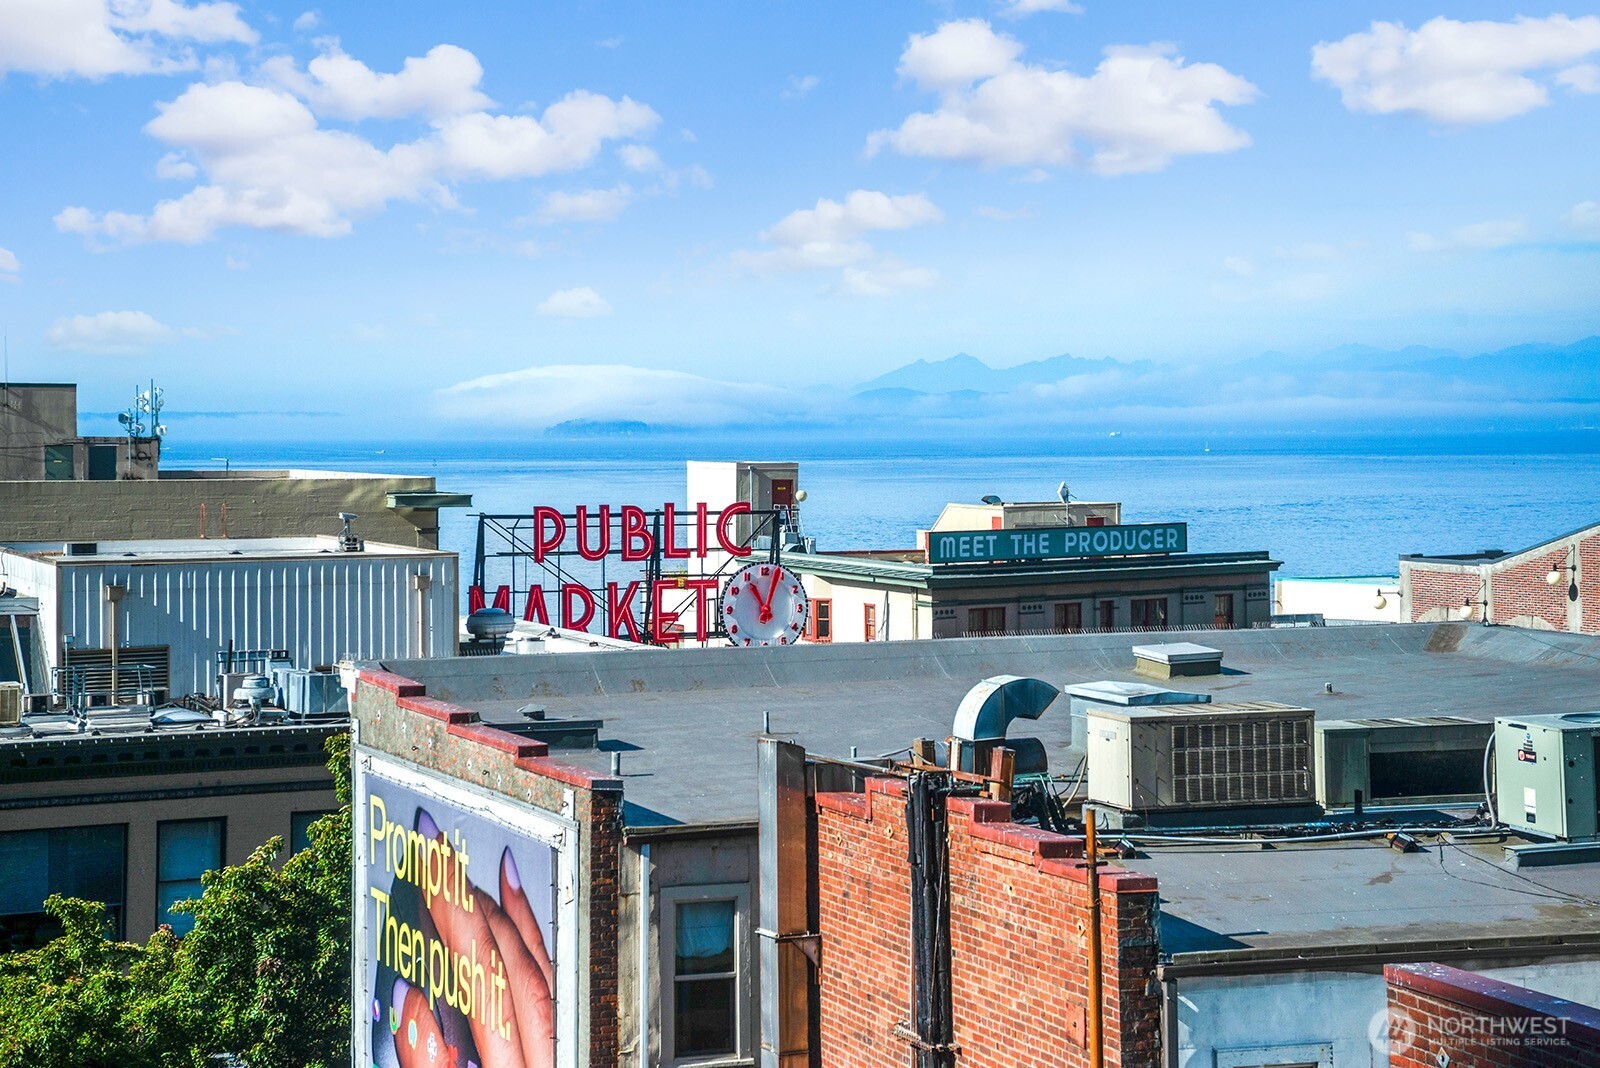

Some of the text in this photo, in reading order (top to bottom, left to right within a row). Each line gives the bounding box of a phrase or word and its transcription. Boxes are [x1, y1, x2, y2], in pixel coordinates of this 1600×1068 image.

[533, 502, 752, 563] PUBLIC
[940, 528, 1179, 559] MEET THE PRODUCER
[760, 566, 770, 576] 12
[743, 572, 751, 581] 11
[729, 586, 740, 596] 10
[792, 585, 799, 594] 2
[726, 605, 734, 615] 9
[796, 603, 803, 613] 3
[730, 624, 738, 634] 8
[791, 622, 799, 632] 4
[370, 886, 511, 1042] Then push it.
